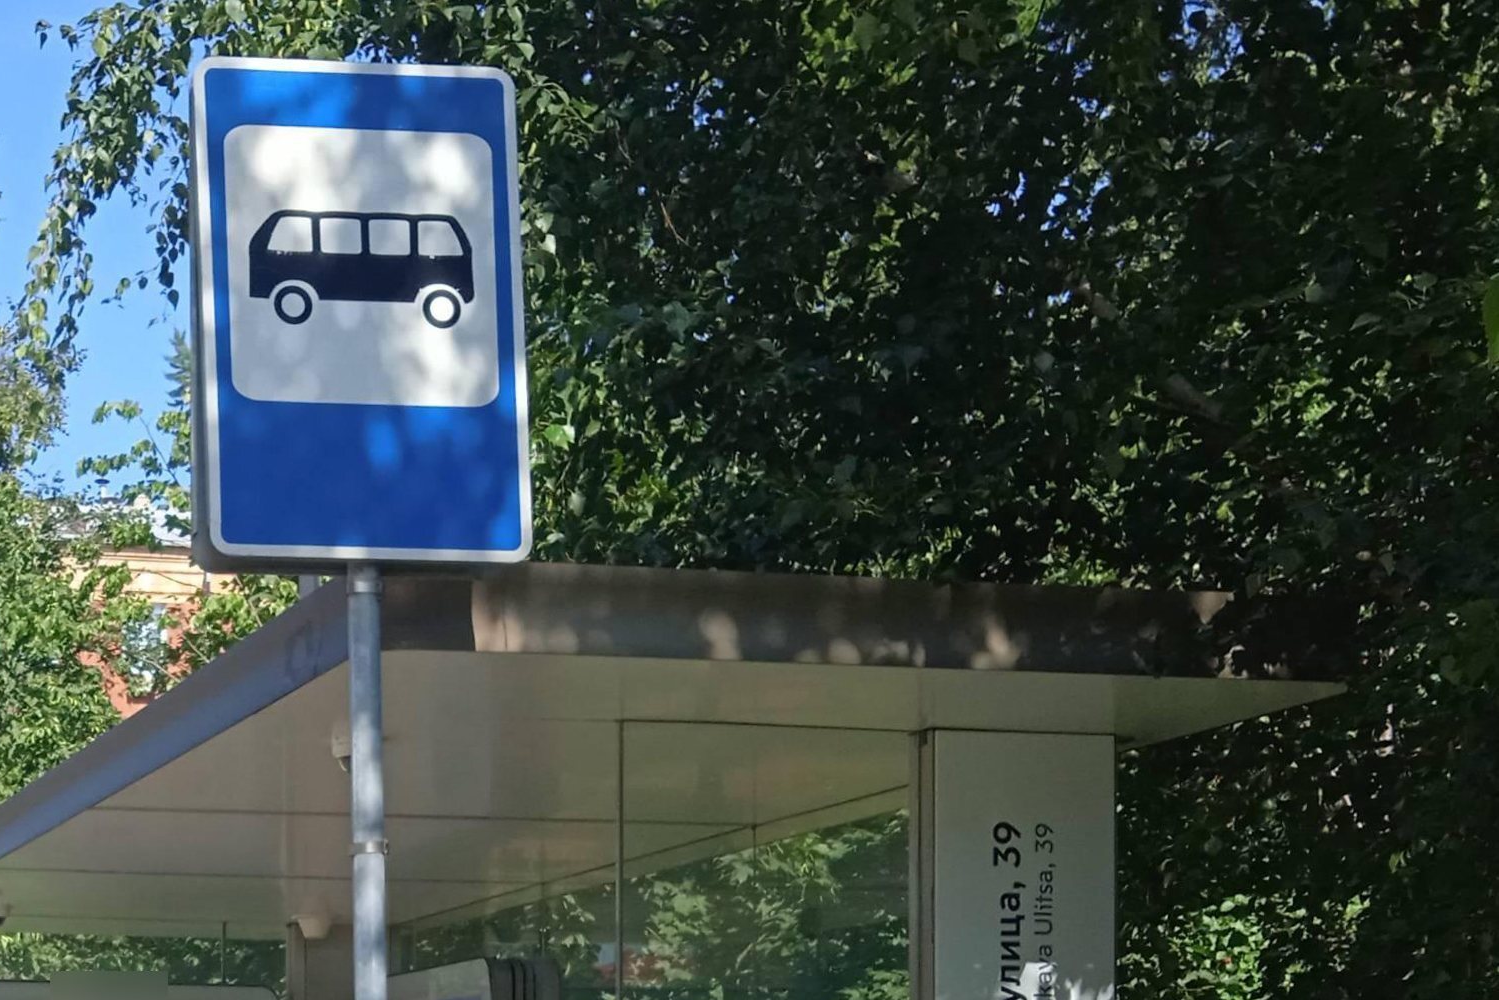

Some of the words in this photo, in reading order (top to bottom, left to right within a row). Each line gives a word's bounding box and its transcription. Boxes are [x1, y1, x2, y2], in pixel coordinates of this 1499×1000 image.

[993, 821, 1021, 868] 39
[1035, 823, 1054, 854] 39
[1034, 863, 1057, 935] Ulitsa,
